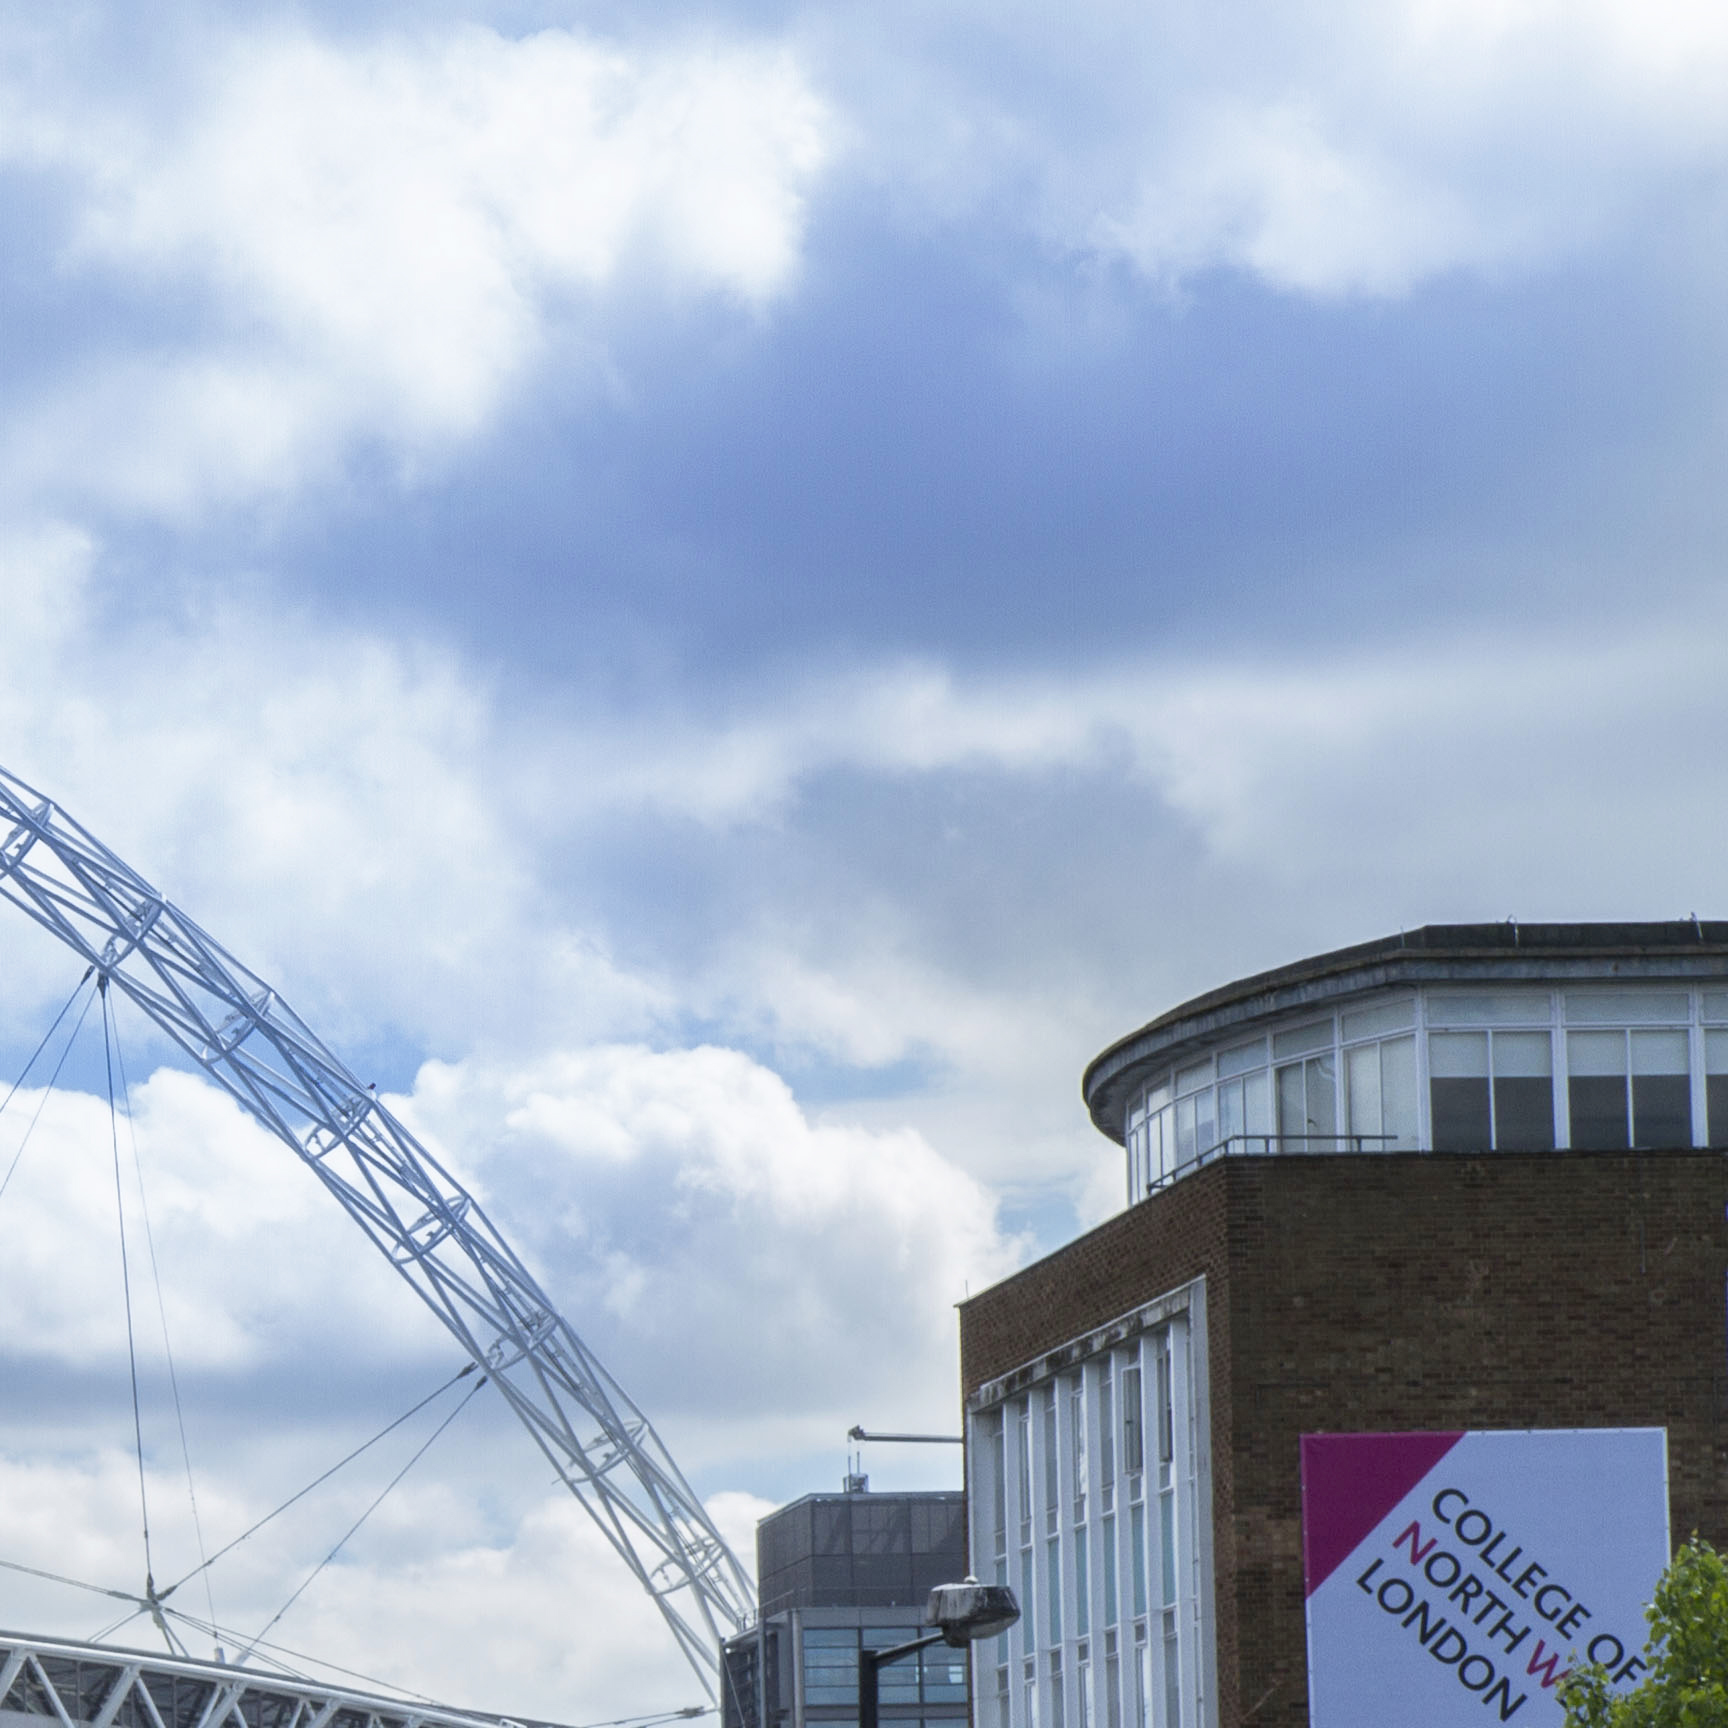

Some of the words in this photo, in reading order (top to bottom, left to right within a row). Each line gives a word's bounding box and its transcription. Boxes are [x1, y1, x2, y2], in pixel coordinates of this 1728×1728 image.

[1356, 1558, 1529, 1723] LONDON
[1391, 1520, 1532, 1655] NORTH
[1432, 1488, 1592, 1641] COLLEGE
[1587, 1633, 1648, 1685] OF
